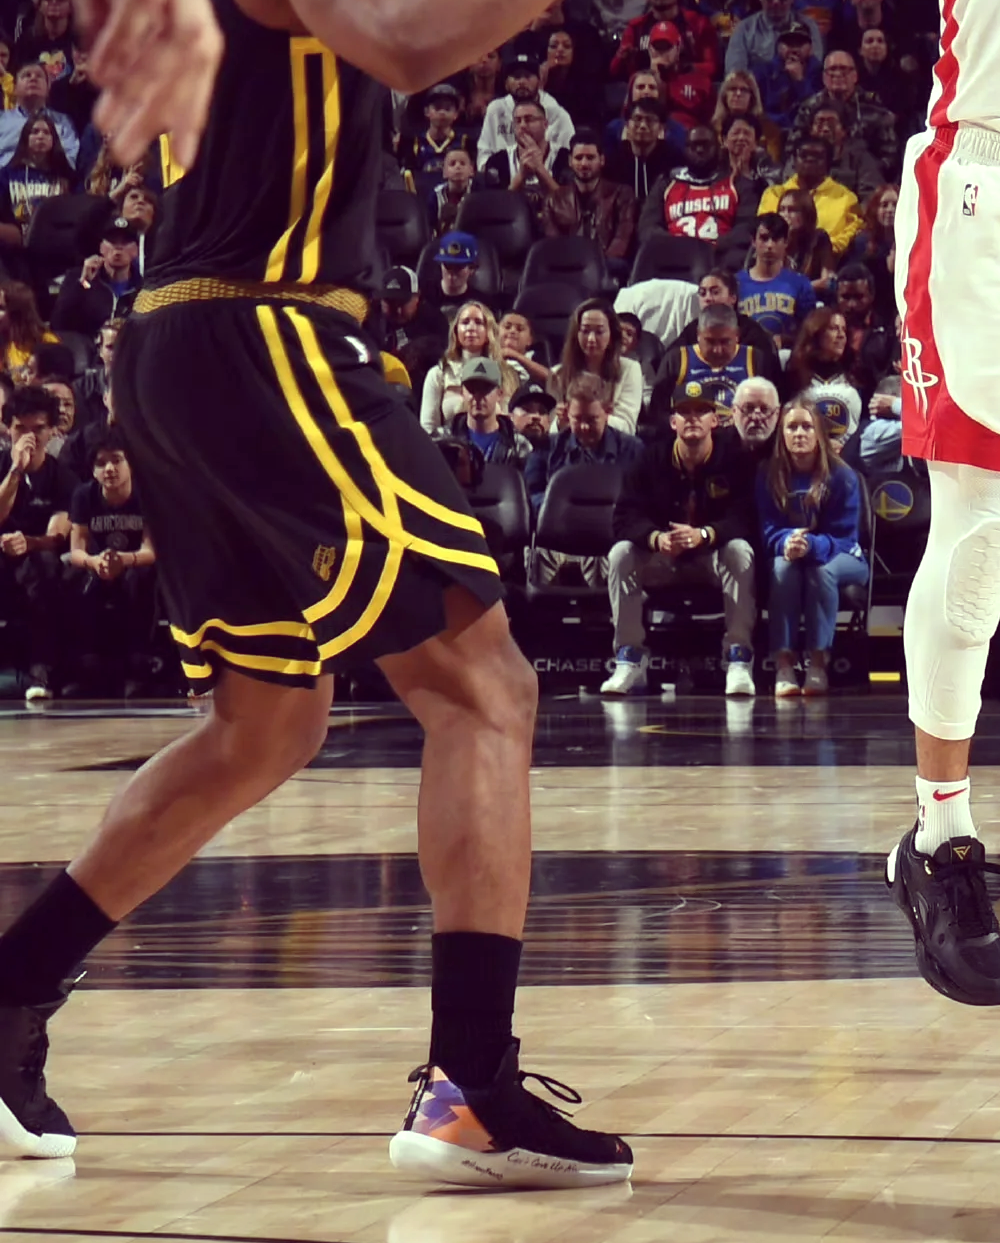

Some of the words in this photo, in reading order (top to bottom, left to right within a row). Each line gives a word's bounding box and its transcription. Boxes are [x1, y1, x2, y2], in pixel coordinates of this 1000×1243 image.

[676, 215, 718, 239] 34
[533, 657, 602, 673] CHASE
[761, 657, 826, 673] CAS
